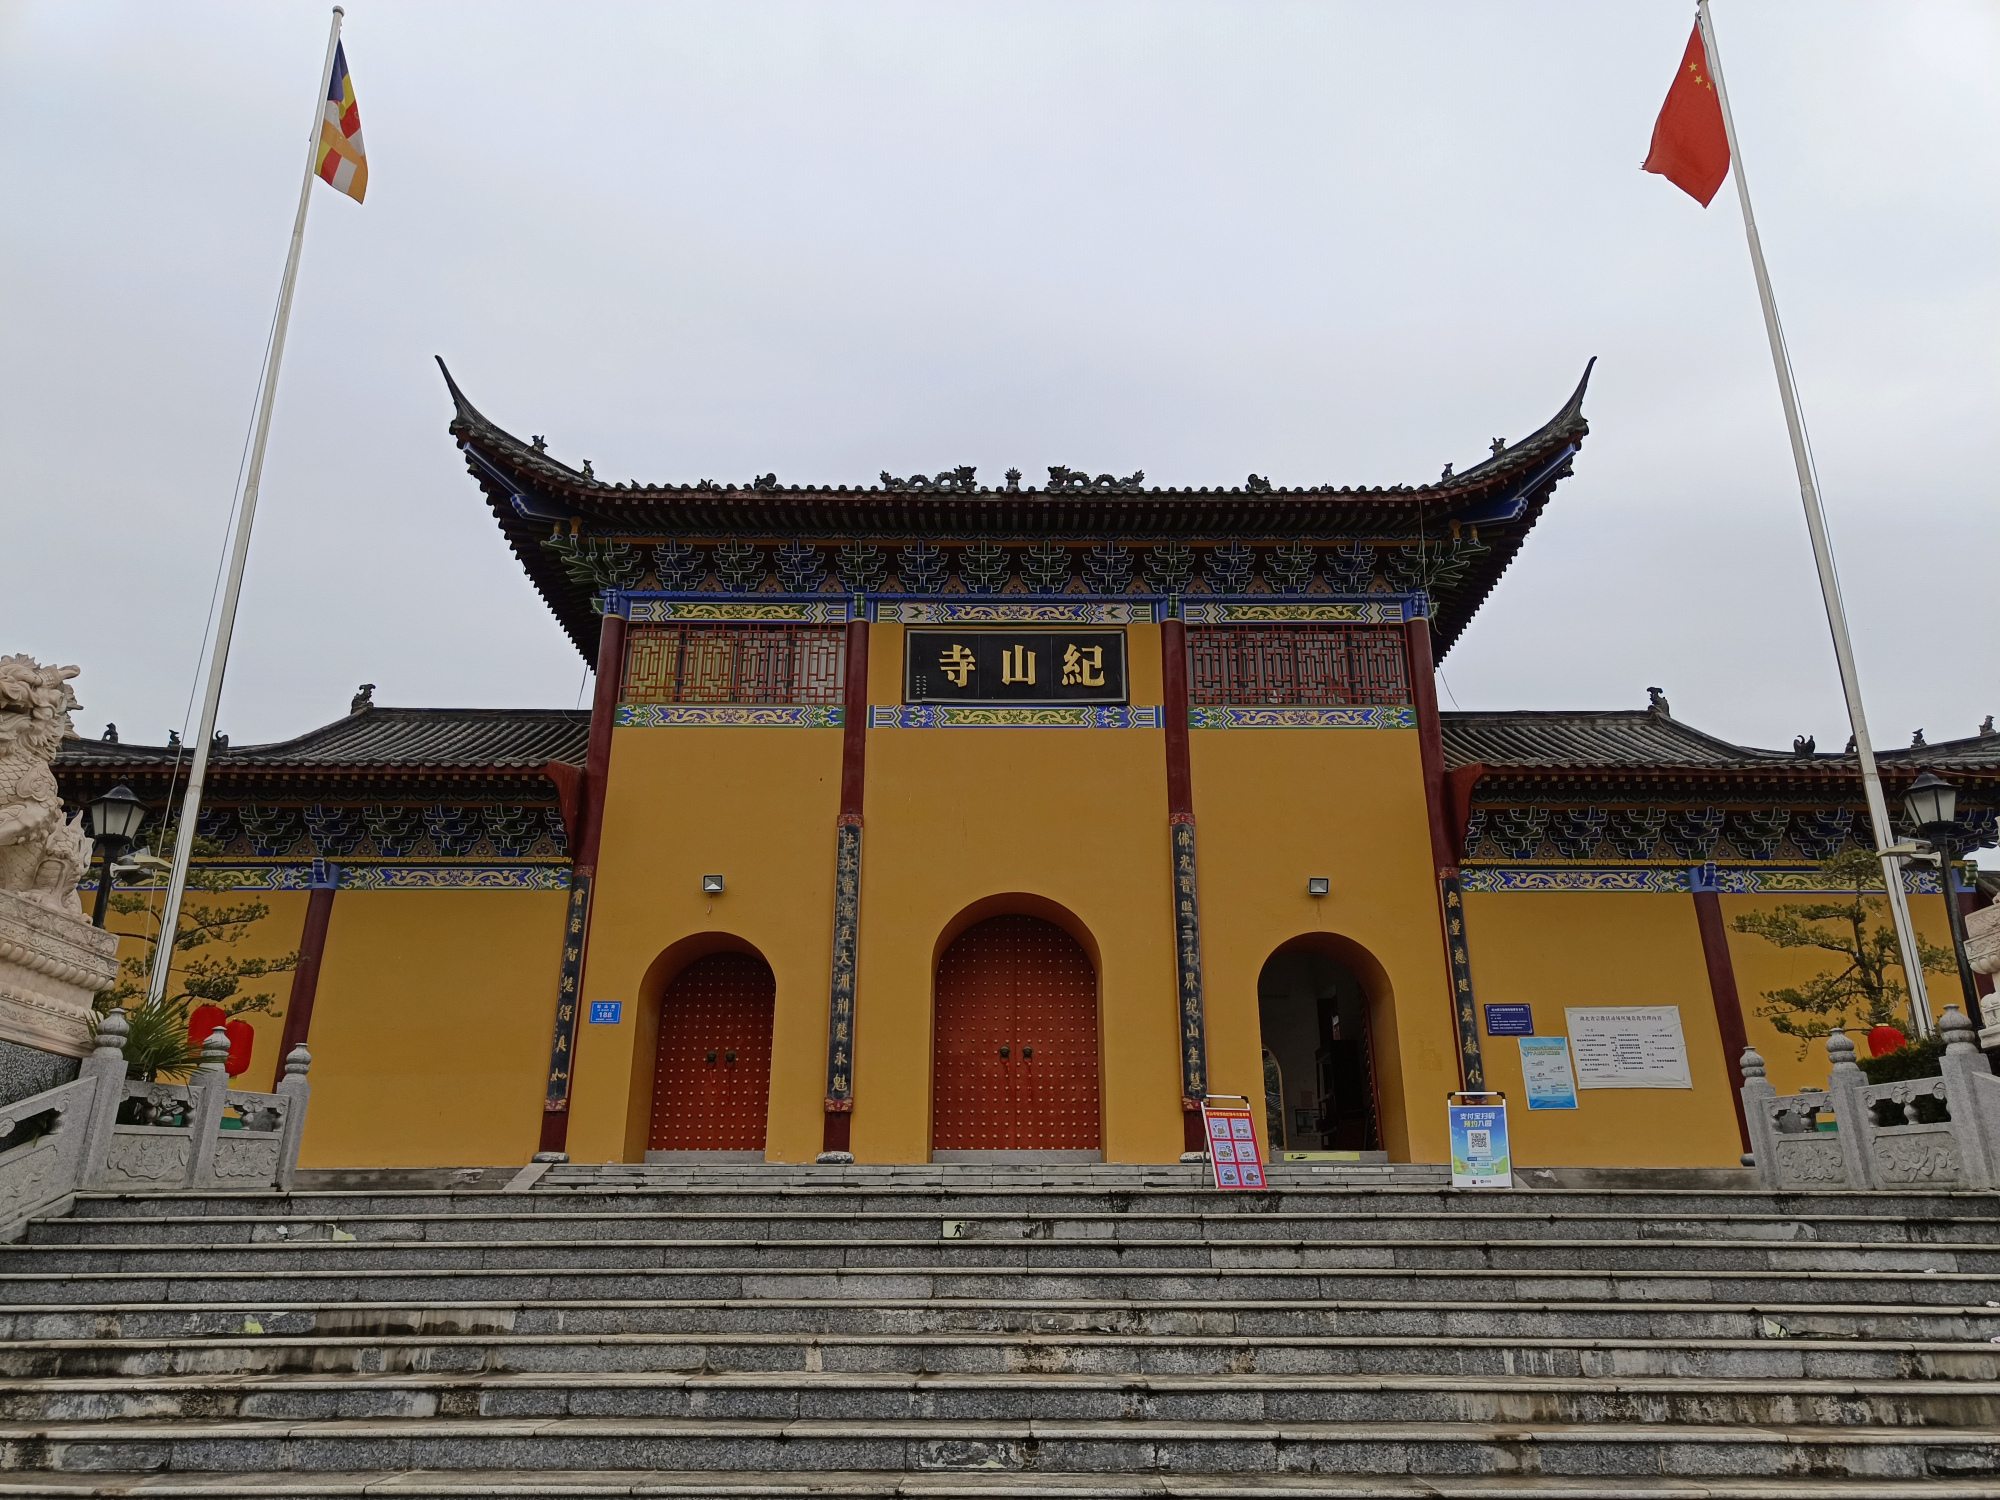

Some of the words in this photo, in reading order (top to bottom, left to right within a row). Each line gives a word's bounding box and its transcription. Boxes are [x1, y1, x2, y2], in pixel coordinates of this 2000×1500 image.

[1460, 1112, 1496, 1120] 支付宝扫码
